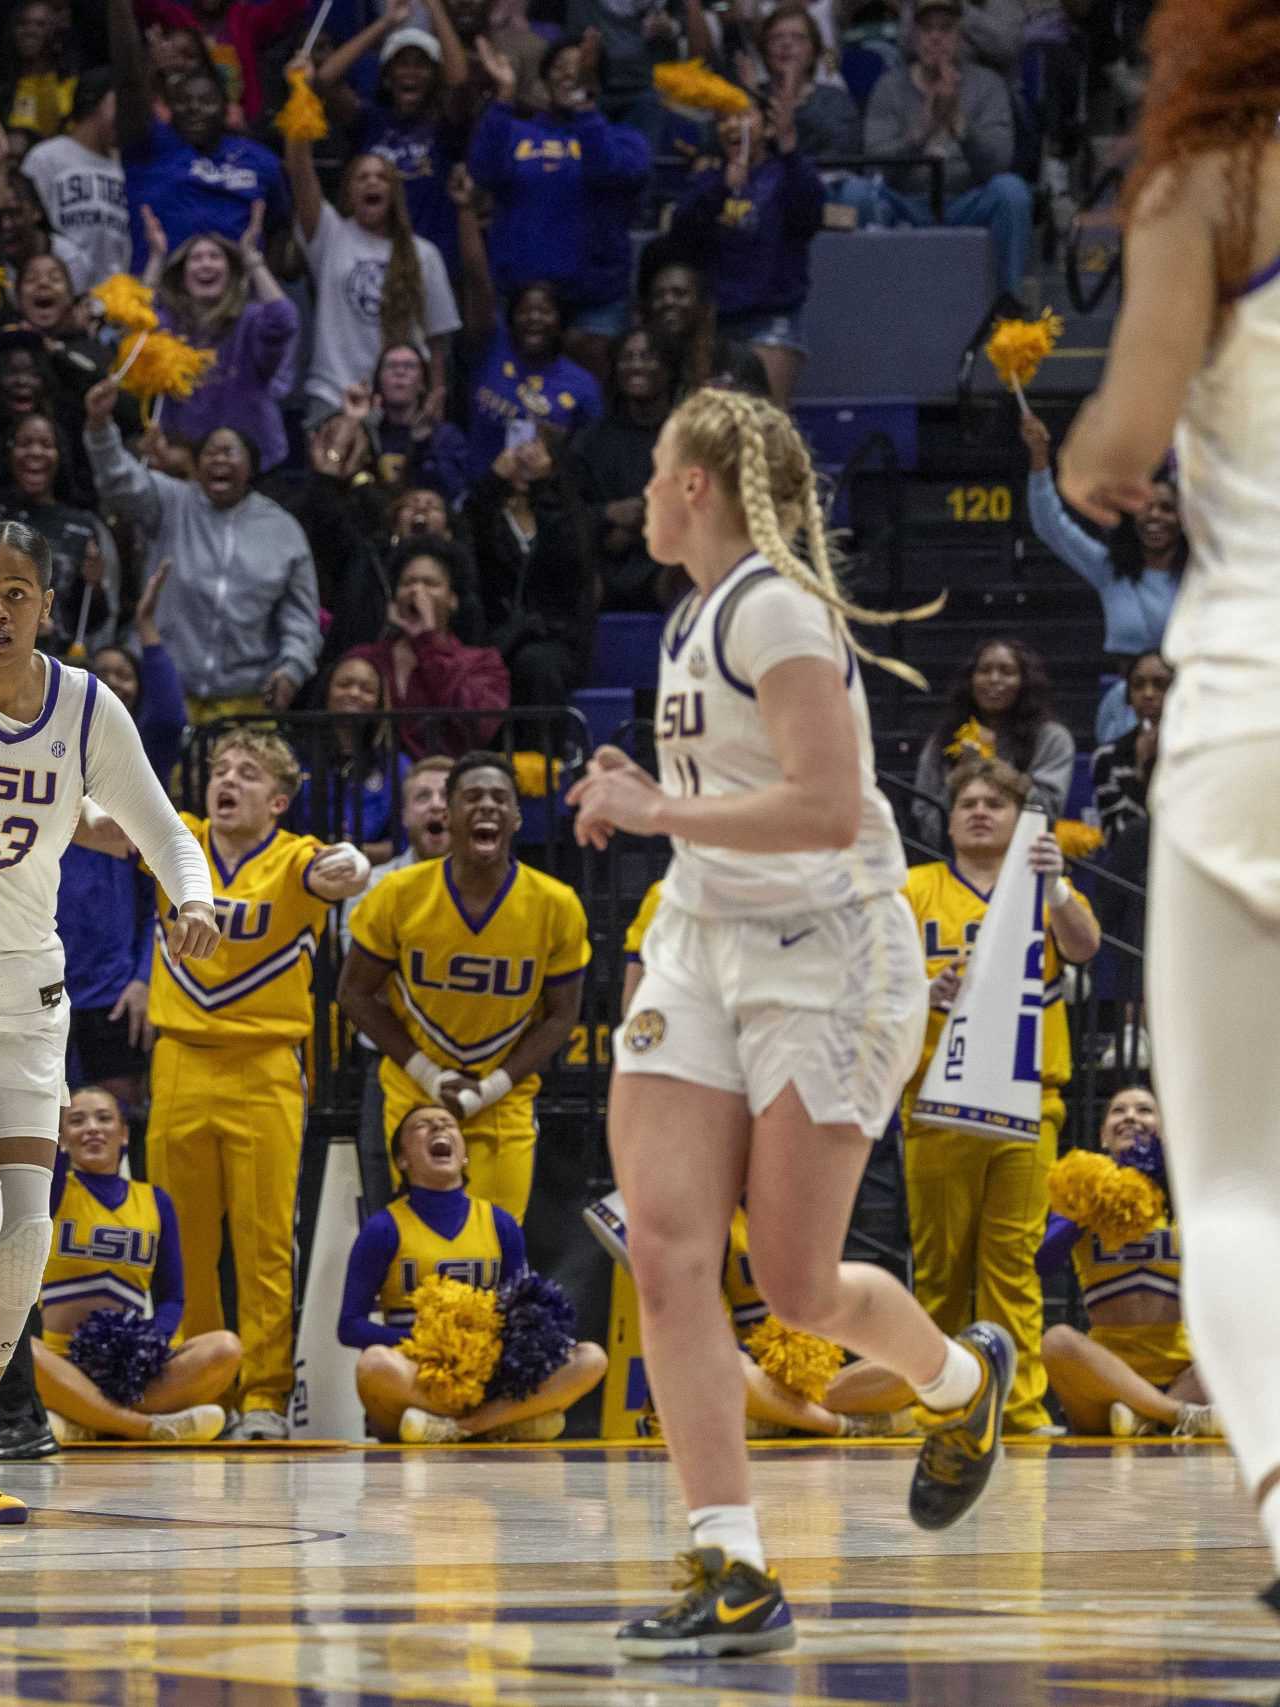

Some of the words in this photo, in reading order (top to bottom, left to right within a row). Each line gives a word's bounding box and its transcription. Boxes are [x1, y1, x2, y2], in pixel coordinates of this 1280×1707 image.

[946, 486, 1012, 522] 120
[52, 741, 66, 758] SEC
[409, 949, 537, 999] LSU
[944, 1016, 967, 1082] LSU
[58, 1219, 158, 1267] LSU
